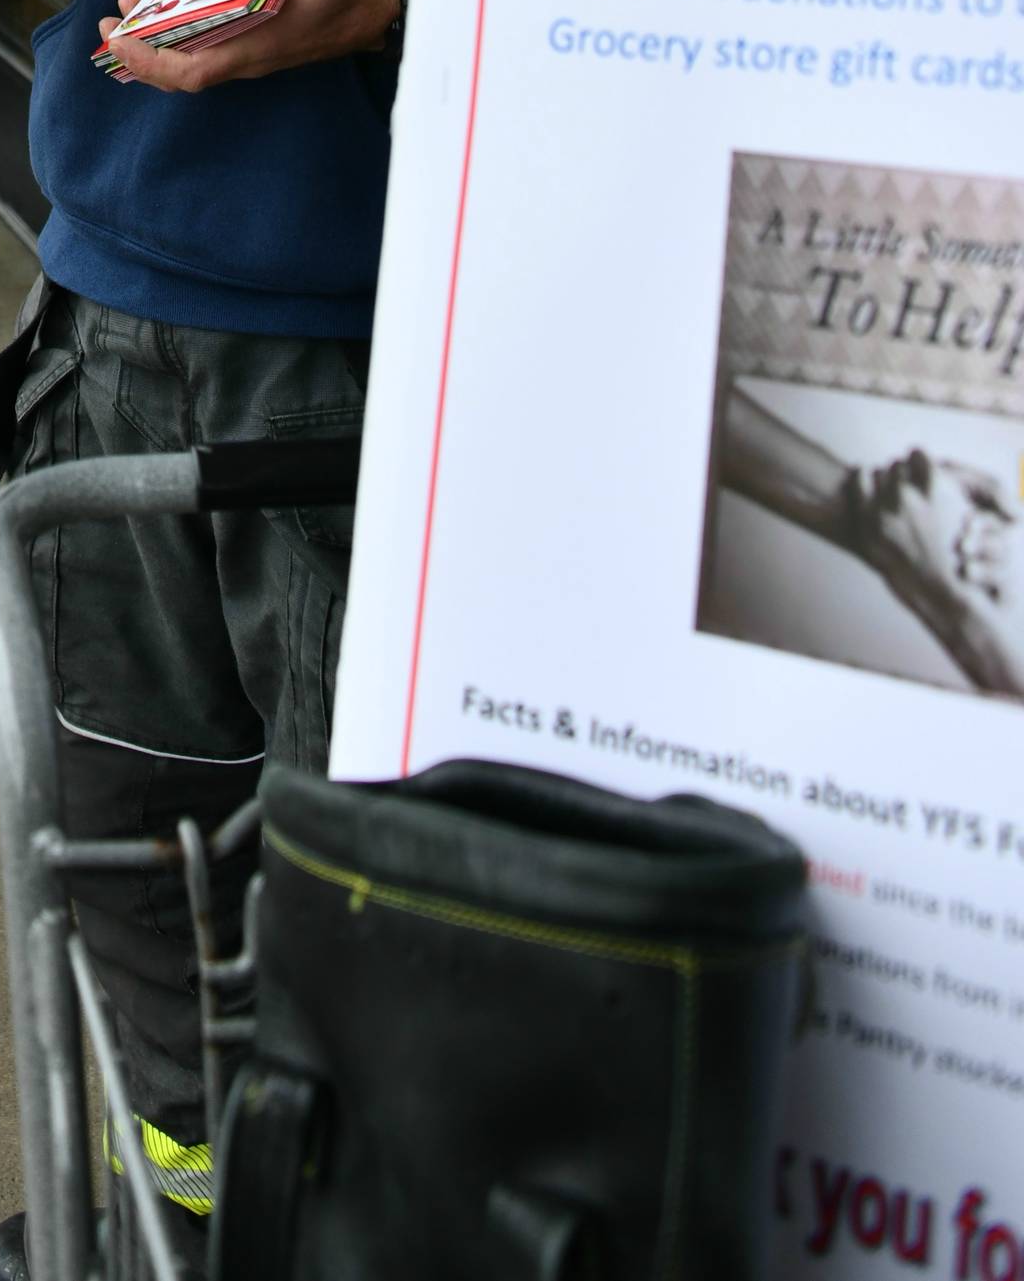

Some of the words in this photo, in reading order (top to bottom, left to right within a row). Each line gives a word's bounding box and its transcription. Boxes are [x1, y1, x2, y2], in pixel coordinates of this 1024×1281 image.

[548, 16, 702, 73] Grocery
[714, 35, 818, 75] store
[829, 39, 897, 87] gift
[911, 48, 1024, 94] cards
[756, 208, 784, 246] A
[802, 208, 904, 258] Little
[806, 265, 879, 337] To
[461, 685, 542, 734] Facts
[552, 707, 577, 741] &
[589, 718, 791, 797] Information
[802, 772, 908, 832] about
[806, 1155, 935, 1266] you
[954, 1184, 1024, 1281] fo
